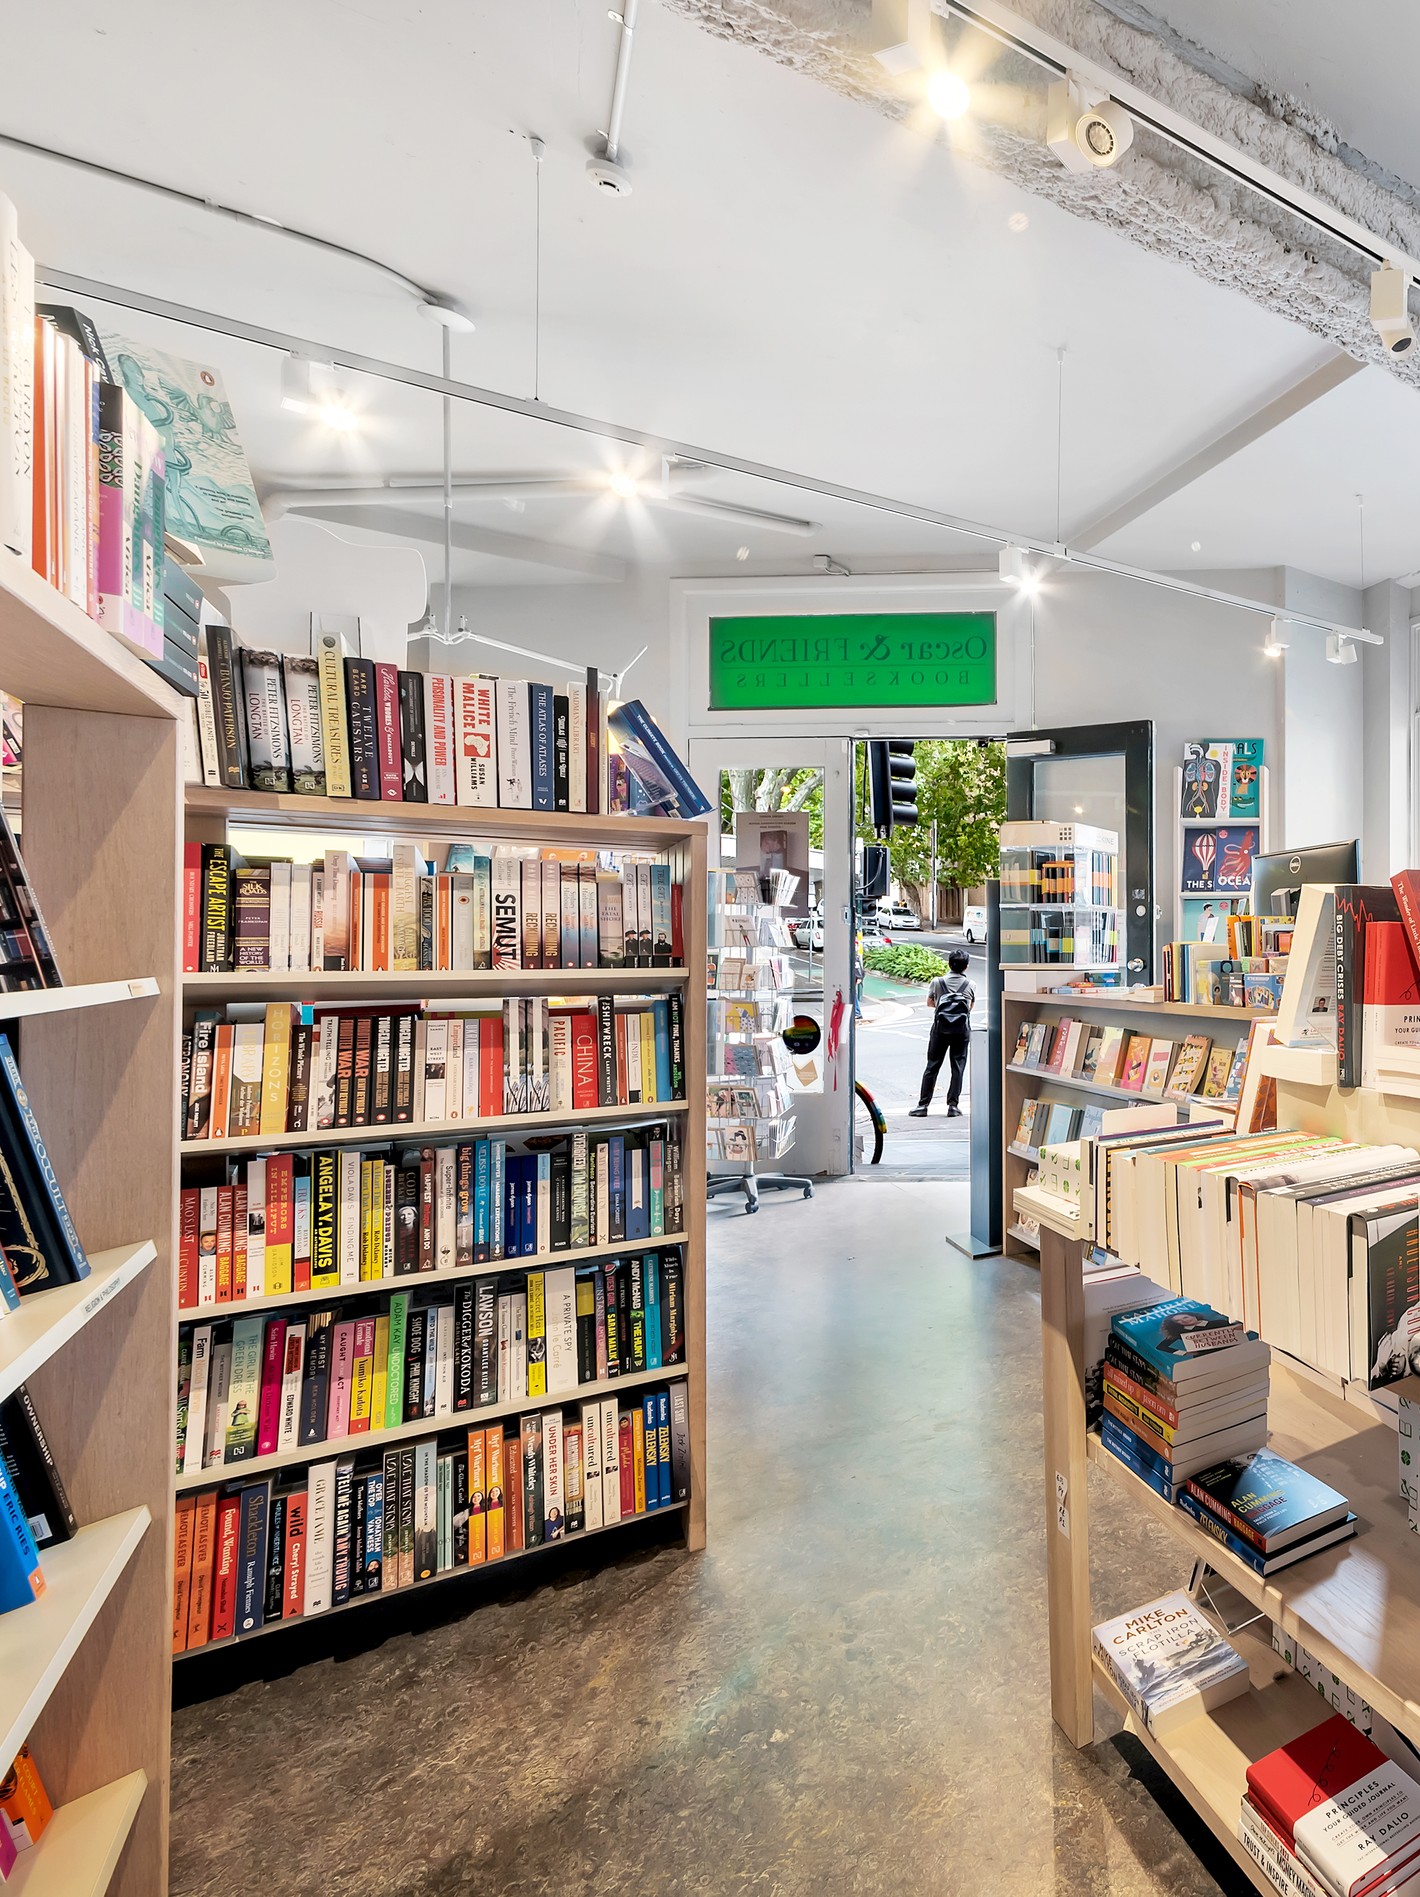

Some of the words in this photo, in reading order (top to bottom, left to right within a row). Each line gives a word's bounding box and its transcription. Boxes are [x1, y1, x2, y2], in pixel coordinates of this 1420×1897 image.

[220, 668, 232, 704] BANJO
[266, 677, 278, 702] PETER
[324, 650, 336, 702] CULTURAL
[463, 683, 476, 729] MALICE
[477, 689, 490, 726] WHITE
[223, 705, 235, 749] PATERSON
[269, 704, 282, 759] FITZSIMONS
[328, 704, 341, 764] TREASURES
[214, 848, 224, 858] THE
[208, 859, 227, 894] ESCAPE
[1187, 880, 1204, 889] THE
[1219, 877, 1250, 885] OCEA
[208, 896, 226, 931] ARTIST
[495, 893, 516, 960] SEMUT
[199, 1022, 211, 1049] Fire
[602, 1005, 612, 1059] SHIPWRECK
[197, 1051, 211, 1094] Island
[269, 1009, 284, 1102] HORIZONS
[576, 1034, 593, 1087] CHINA
[37, 1144, 64, 1211] OCCULT
[319, 1157, 333, 1212] ANGELA
[319, 1212, 332, 1225] Y.
[318, 1226, 333, 1268] DAVIS
[394, 1302, 403, 1324] ADAM
[479, 1285, 493, 1337] LAWSON
[392, 1325, 401, 1345] KAY
[1185, 1328, 1235, 1340] CURRENTLY
[1193, 1333, 1233, 1344] BETWEEN
[1195, 1339, 1239, 1349] HUSBANDS
[389, 1347, 400, 1404] UNDOCTORED
[23, 1395, 53, 1467] OWNERSHIP
[587, 1416, 597, 1467] uncultured
[1231, 1493, 1255, 1507] ALAN
[1238, 1489, 1284, 1513] CUMMING
[3, 1492, 18, 1525] ERIC
[15, 1525, 30, 1555] RIES
[246, 1495, 263, 1557] Shackleton
[289, 1506, 302, 1538] wild
[1200, 1512, 1228, 1545] ZELENSKY
[290, 1543, 300, 1569] Cheryl
[289, 1571, 299, 1600] Strayed
[1113, 1608, 1188, 1645] CARLTON
[1119, 1634, 1162, 1656] SCRAP
[1166, 1618, 1198, 1634] IRON
[1125, 1609, 1166, 1629] MIKE
[1133, 1629, 1196, 1658] FLOTILLA
[1323, 1819, 1341, 1832] YOUR
[1343, 1802, 1366, 1819] GUIDED
[1368, 1782, 1395, 1803] JOURNAL
[1325, 1780, 1380, 1818] PRINCIPLES
[1358, 1835, 1377, 1850] RAY
[1379, 1812, 1409, 1835] DALIO
[1243, 1832, 1260, 1859] TRUST
[1260, 1853, 1266, 1866] &
[1266, 1860, 1288, 1895] INSPIRE
